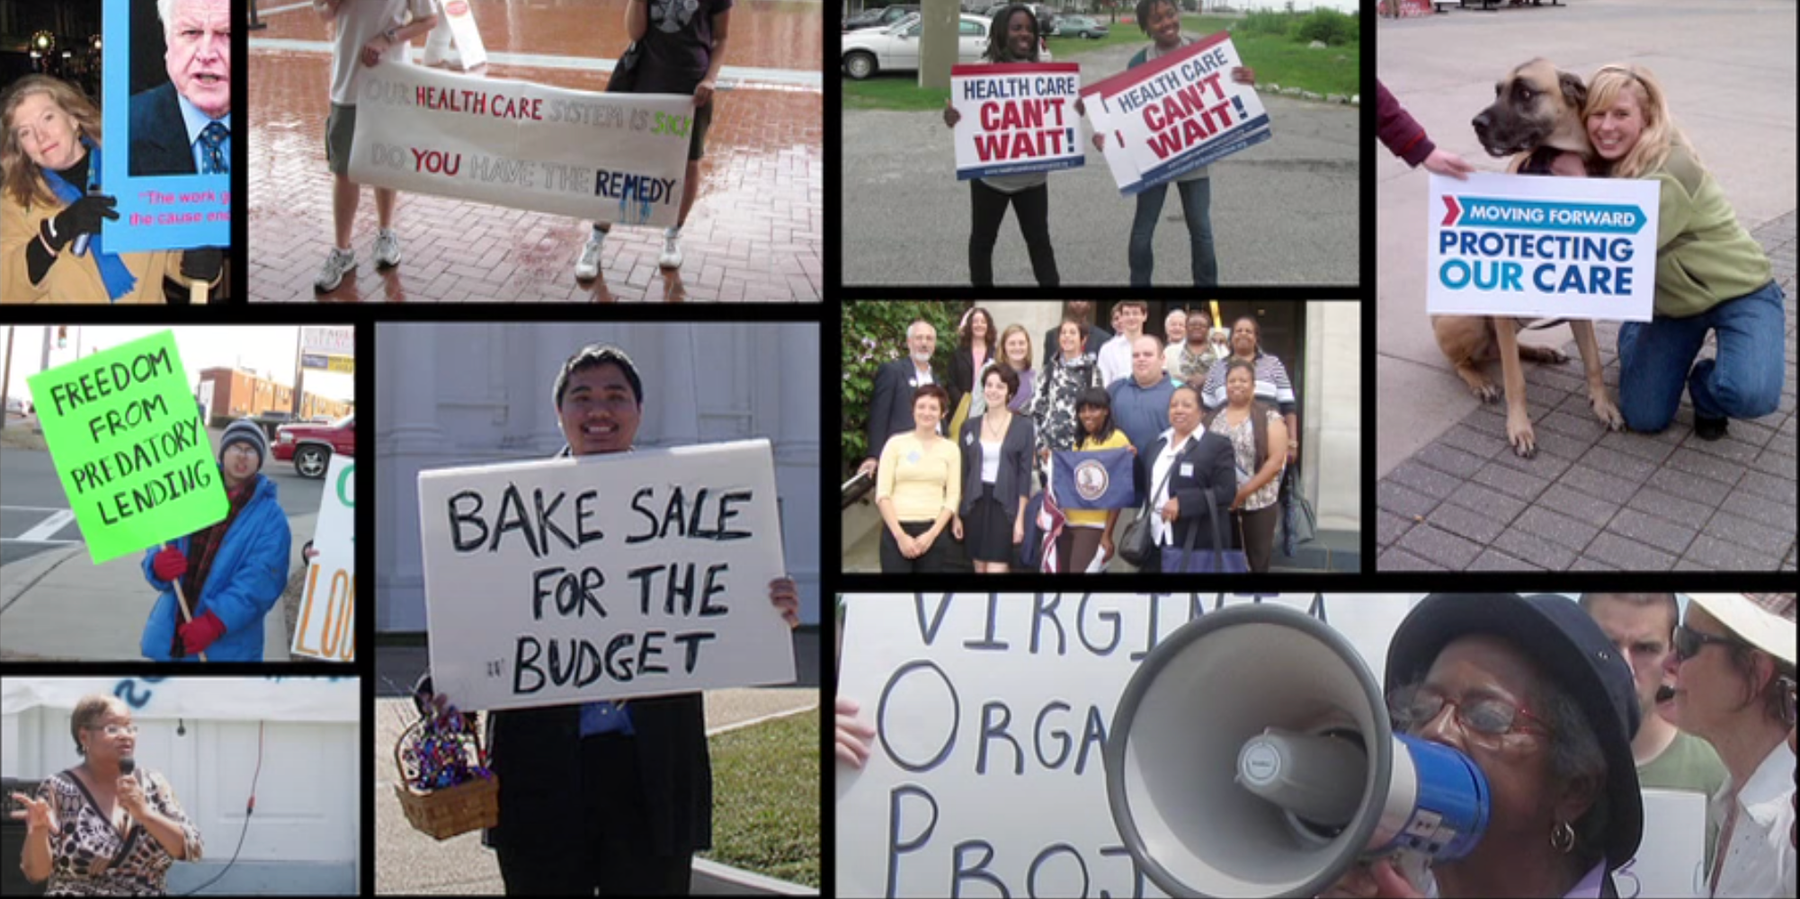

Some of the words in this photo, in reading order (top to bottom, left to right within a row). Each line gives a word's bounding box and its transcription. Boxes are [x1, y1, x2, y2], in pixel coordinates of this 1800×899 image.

[363, 77, 412, 106] OUR
[416, 85, 486, 114] HEALTH
[491, 94, 543, 121] CARE
[549, 100, 623, 128] SYSTEM
[628, 107, 649, 131] IS
[963, 77, 1030, 100] HEALTH
[1035, 76, 1076, 96] CARE
[1118, 70, 1180, 114] HEALTH
[1180, 47, 1229, 81] CARE
[1142, 72, 1225, 132] CAN'T
[980, 98, 1066, 131] CAN'T
[1146, 94, 1249, 160] WAIT!
[973, 127, 1075, 162] WAIT!
[179, 189, 215, 204] work
[370, 142, 406, 173] DO
[411, 147, 461, 178] YOU
[470, 155, 536, 188] HAVE
[542, 161, 591, 194] THE
[594, 169, 677, 206] REMEDY
[129, 212, 153, 226] the
[158, 211, 203, 225] cause
[1469, 204, 1544, 222] MOVING
[1549, 208, 1636, 227] FORWARD
[1439, 231, 1635, 262] PROTECTING
[1439, 259, 1524, 292] OUR
[1533, 263, 1634, 296] CARE
[50, 346, 174, 417] FREEDOM
[88, 393, 169, 444] FROM
[70, 415, 201, 494] PREDATORY
[97, 459, 211, 526] LENDING
[448, 481, 604, 557] BAKE
[625, 486, 753, 544] SALE
[533, 566, 608, 621] FOR
[627, 564, 729, 617] THE
[912, 593, 1328, 661] VIRGI
[513, 631, 716, 695] BUDGET
